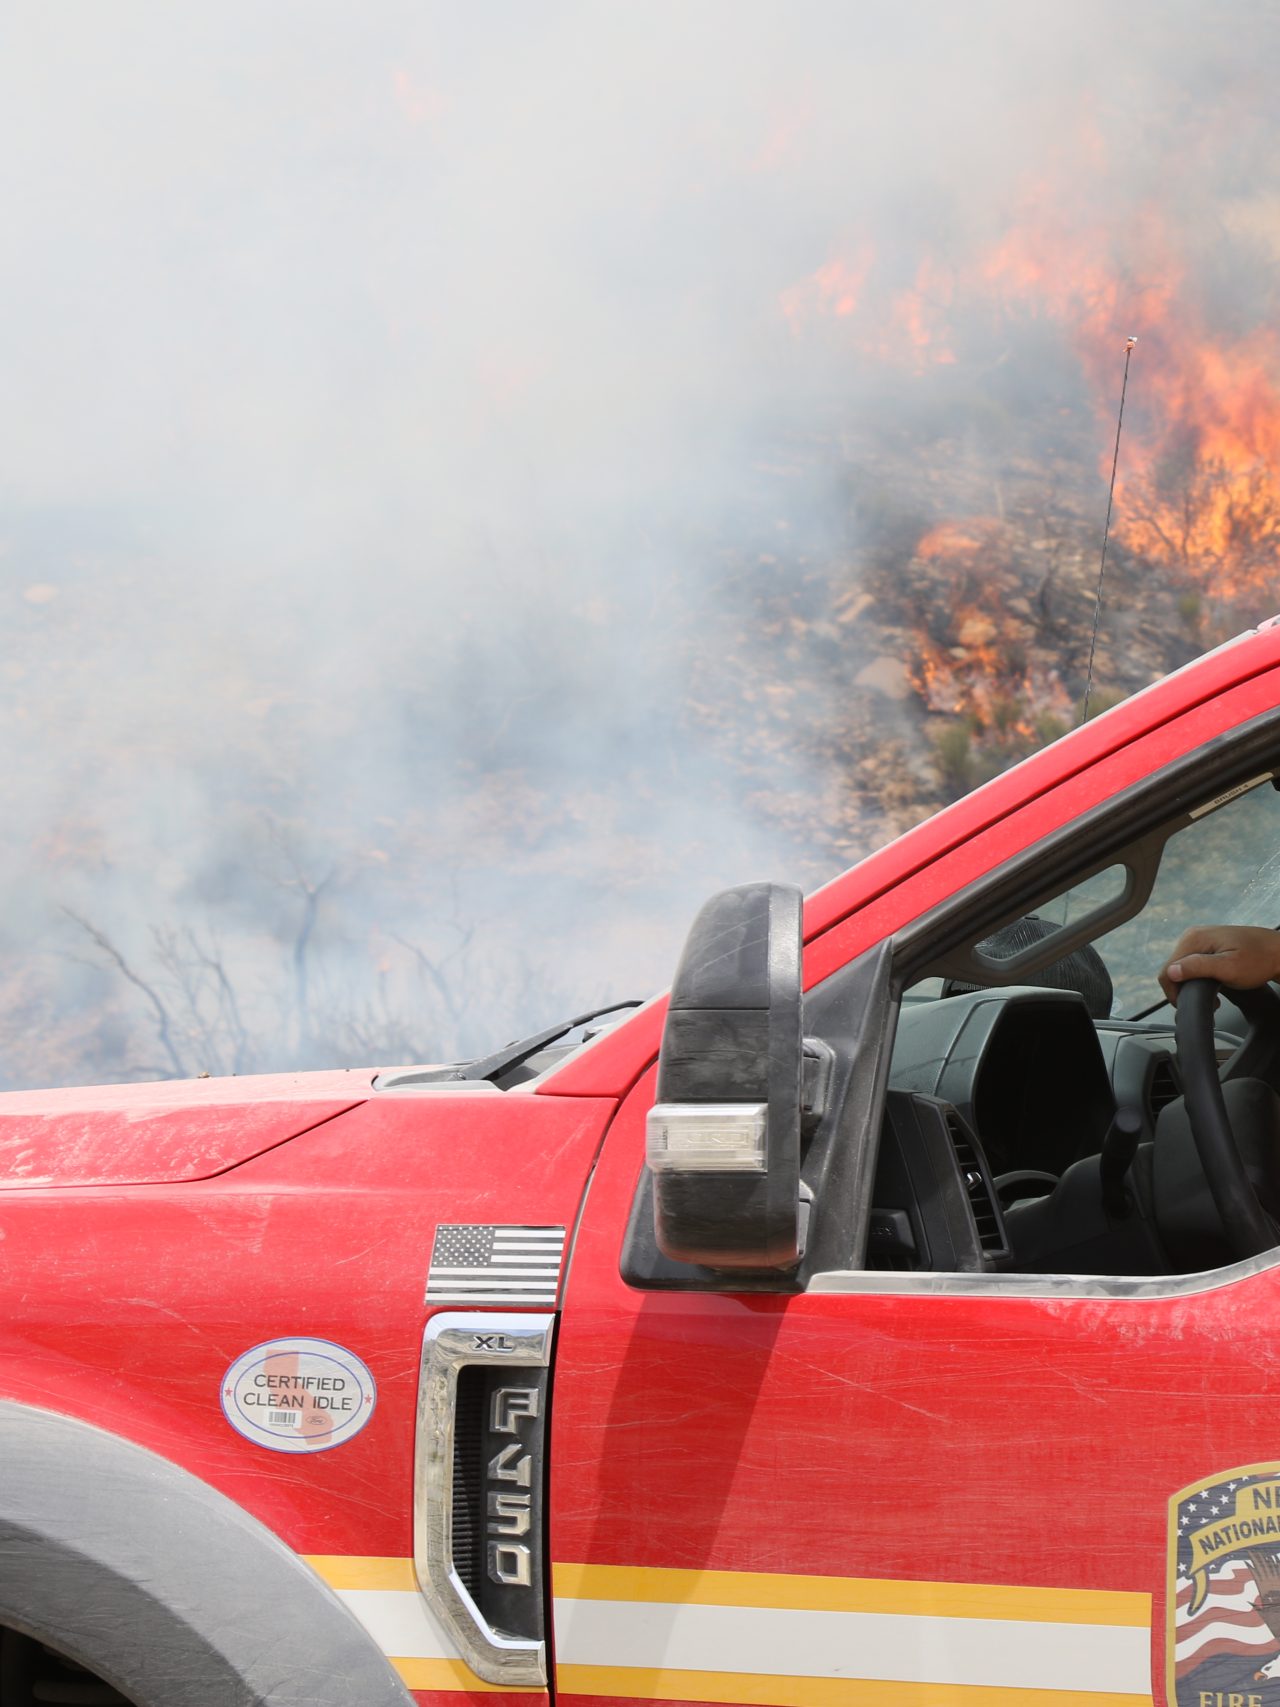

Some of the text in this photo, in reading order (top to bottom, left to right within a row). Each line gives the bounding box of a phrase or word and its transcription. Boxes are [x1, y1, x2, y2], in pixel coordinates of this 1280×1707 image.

[472, 1335, 515, 1352] XL
[254, 1374, 345, 1391] CERTIFIED
[243, 1392, 352, 1411] CLEAN IDLE
